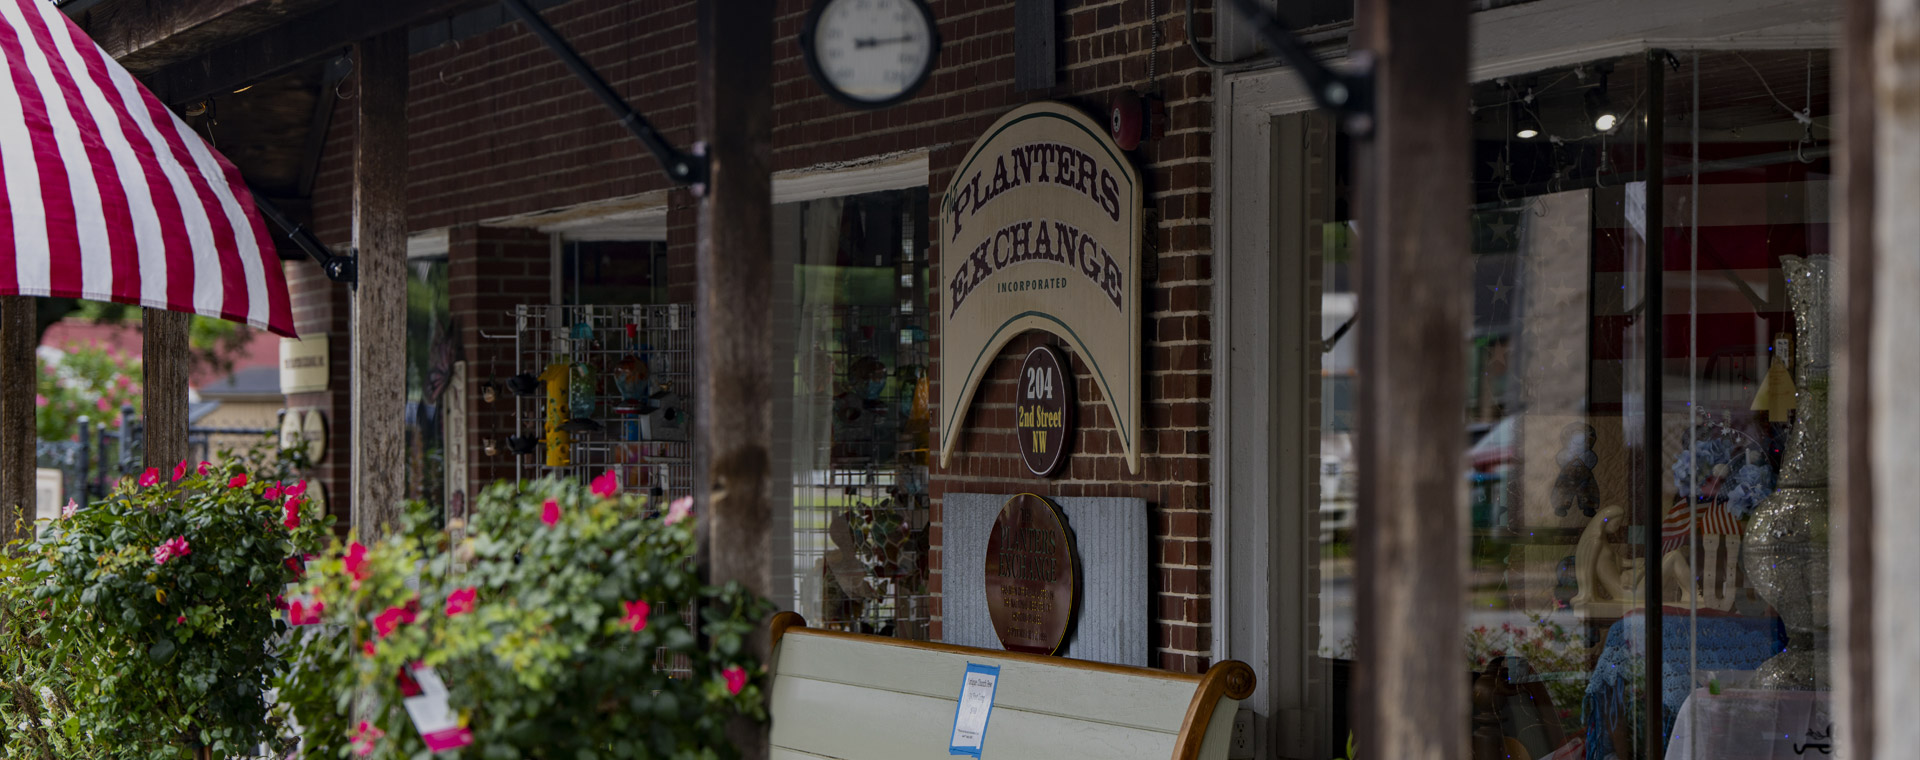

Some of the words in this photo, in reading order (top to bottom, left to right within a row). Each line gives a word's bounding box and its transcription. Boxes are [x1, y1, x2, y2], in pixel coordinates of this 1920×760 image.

[952, 143, 1120, 243] PLANTERS
[950, 220, 1122, 321] EXCHANGE
[998, 277, 1067, 293] INCORPORATED
[1027, 367, 1052, 399] 204
[1019, 405, 1034, 428] 2nd
[1036, 405, 1062, 428] Street
[1032, 430, 1047, 453] NW
[1000, 526, 1056, 556] PLANTERS
[998, 552, 1057, 583] EXCHANGE
